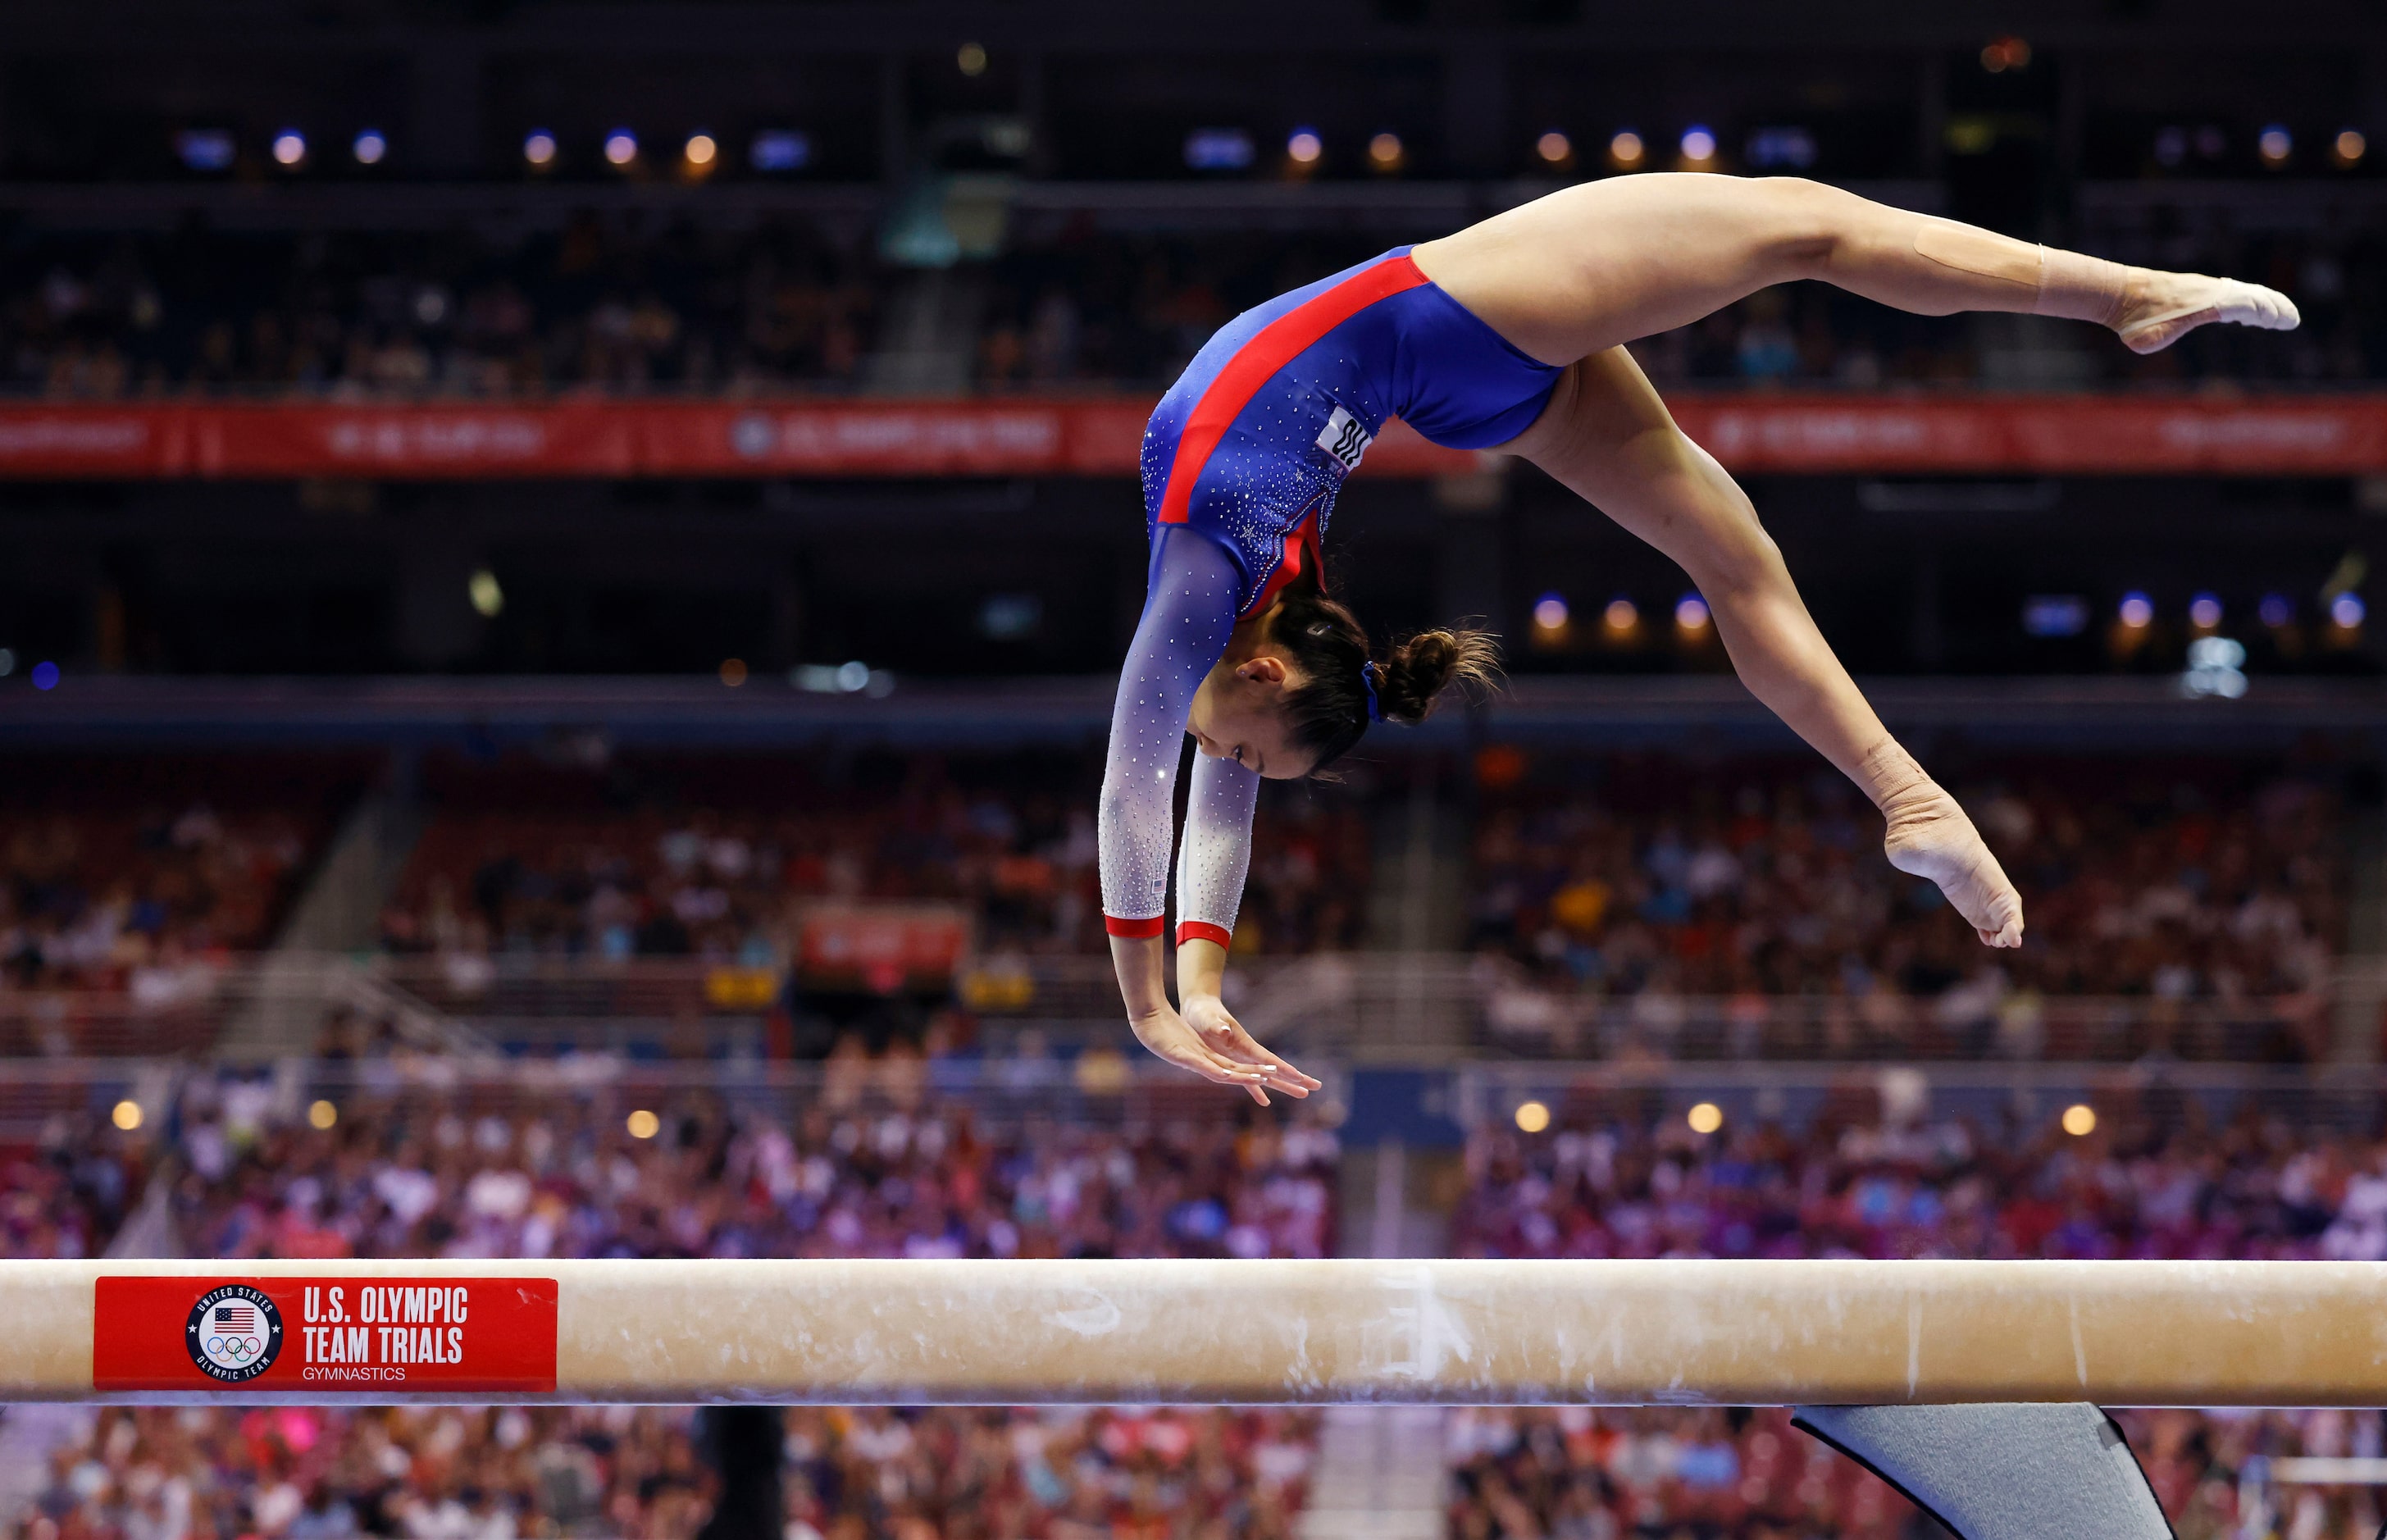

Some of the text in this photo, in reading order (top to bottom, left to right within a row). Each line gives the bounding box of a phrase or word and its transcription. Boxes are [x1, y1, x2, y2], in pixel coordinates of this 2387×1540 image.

[197, 1287, 273, 1313] UNITED STATES
[303, 1286, 468, 1324] U.S. OLYMPIC
[303, 1326, 463, 1365] TEAM TRIALS
[196, 1355, 271, 1380] OLYMPIC TEAM
[303, 1366, 406, 1381] GYMNASTICS
